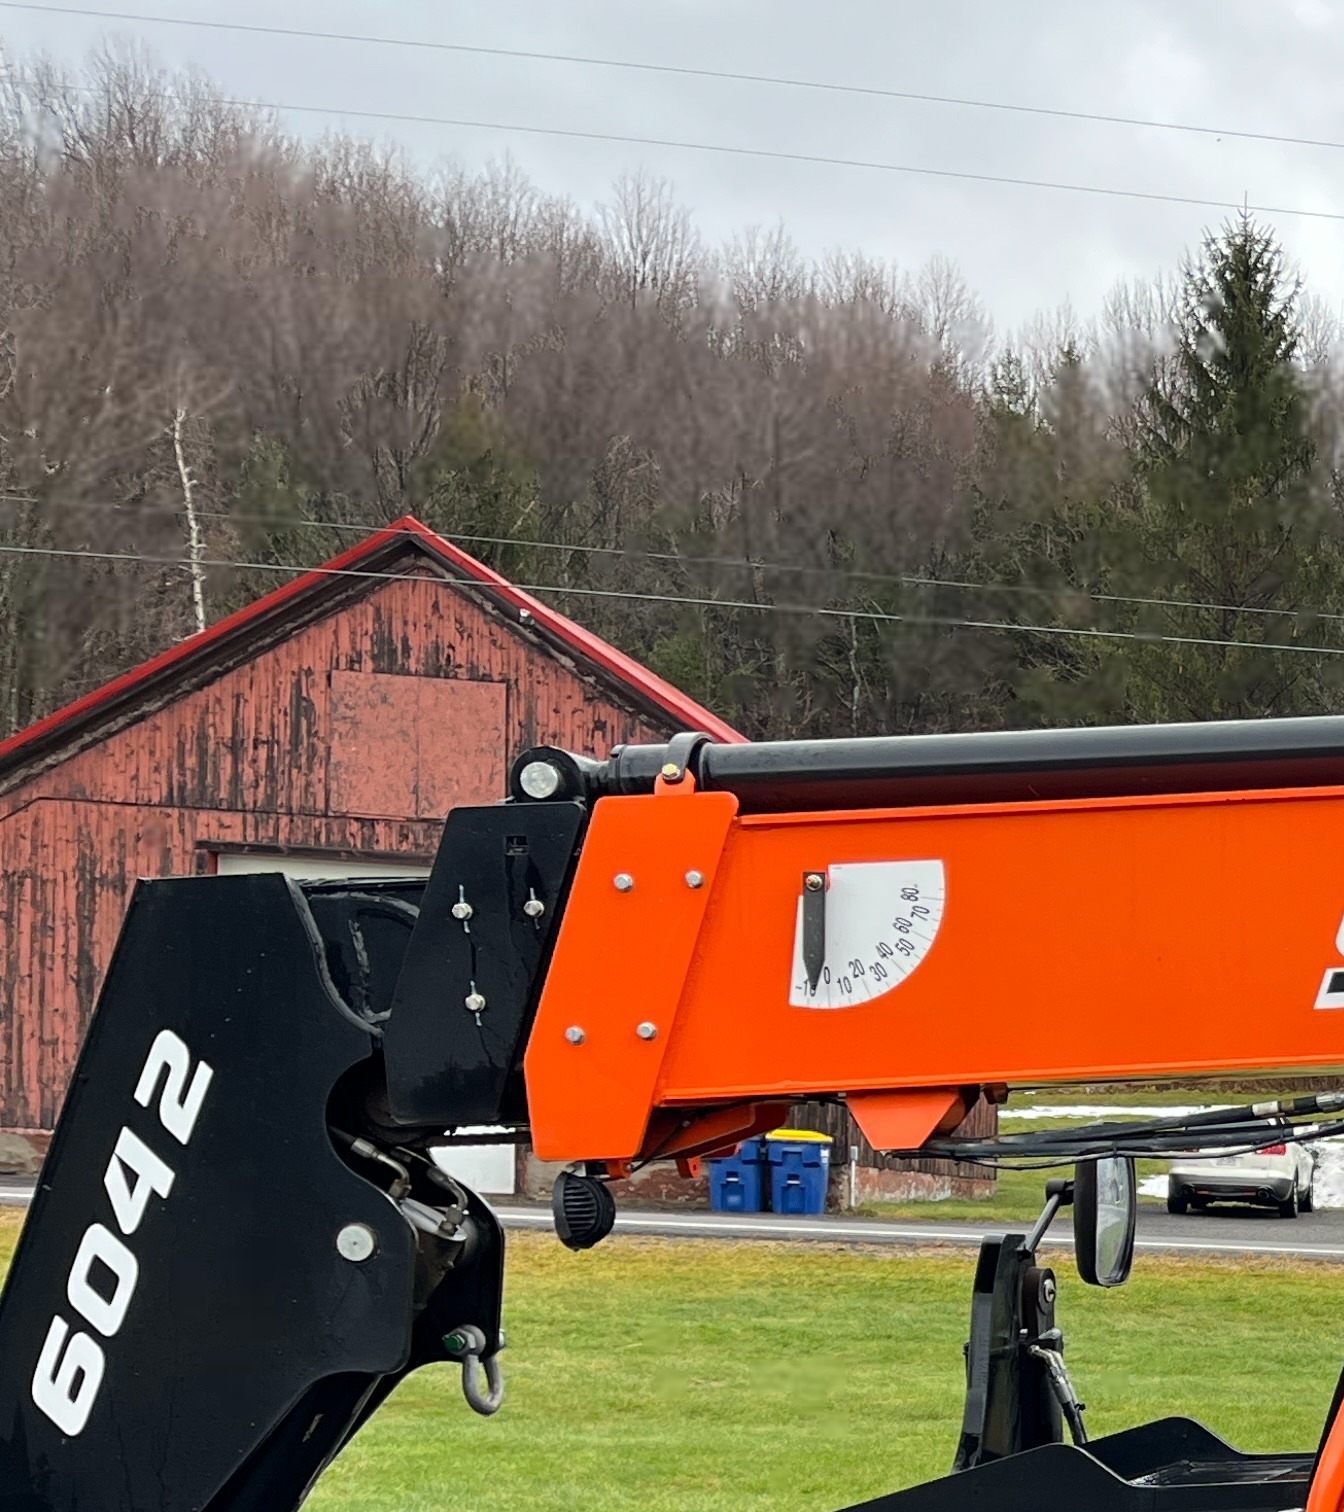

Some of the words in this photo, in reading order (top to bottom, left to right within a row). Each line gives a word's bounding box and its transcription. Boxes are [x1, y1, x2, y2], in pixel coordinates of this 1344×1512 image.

[910, 905, 930, 922] 70
[892, 917, 913, 934] 60
[875, 941, 894, 960] 40
[895, 938, 915, 957] 50
[823, 966, 831, 985] 0
[848, 958, 865, 979] 20
[869, 962, 888, 982] 30
[837, 975, 852, 996] 10
[32, 1029, 214, 1437] 6042
